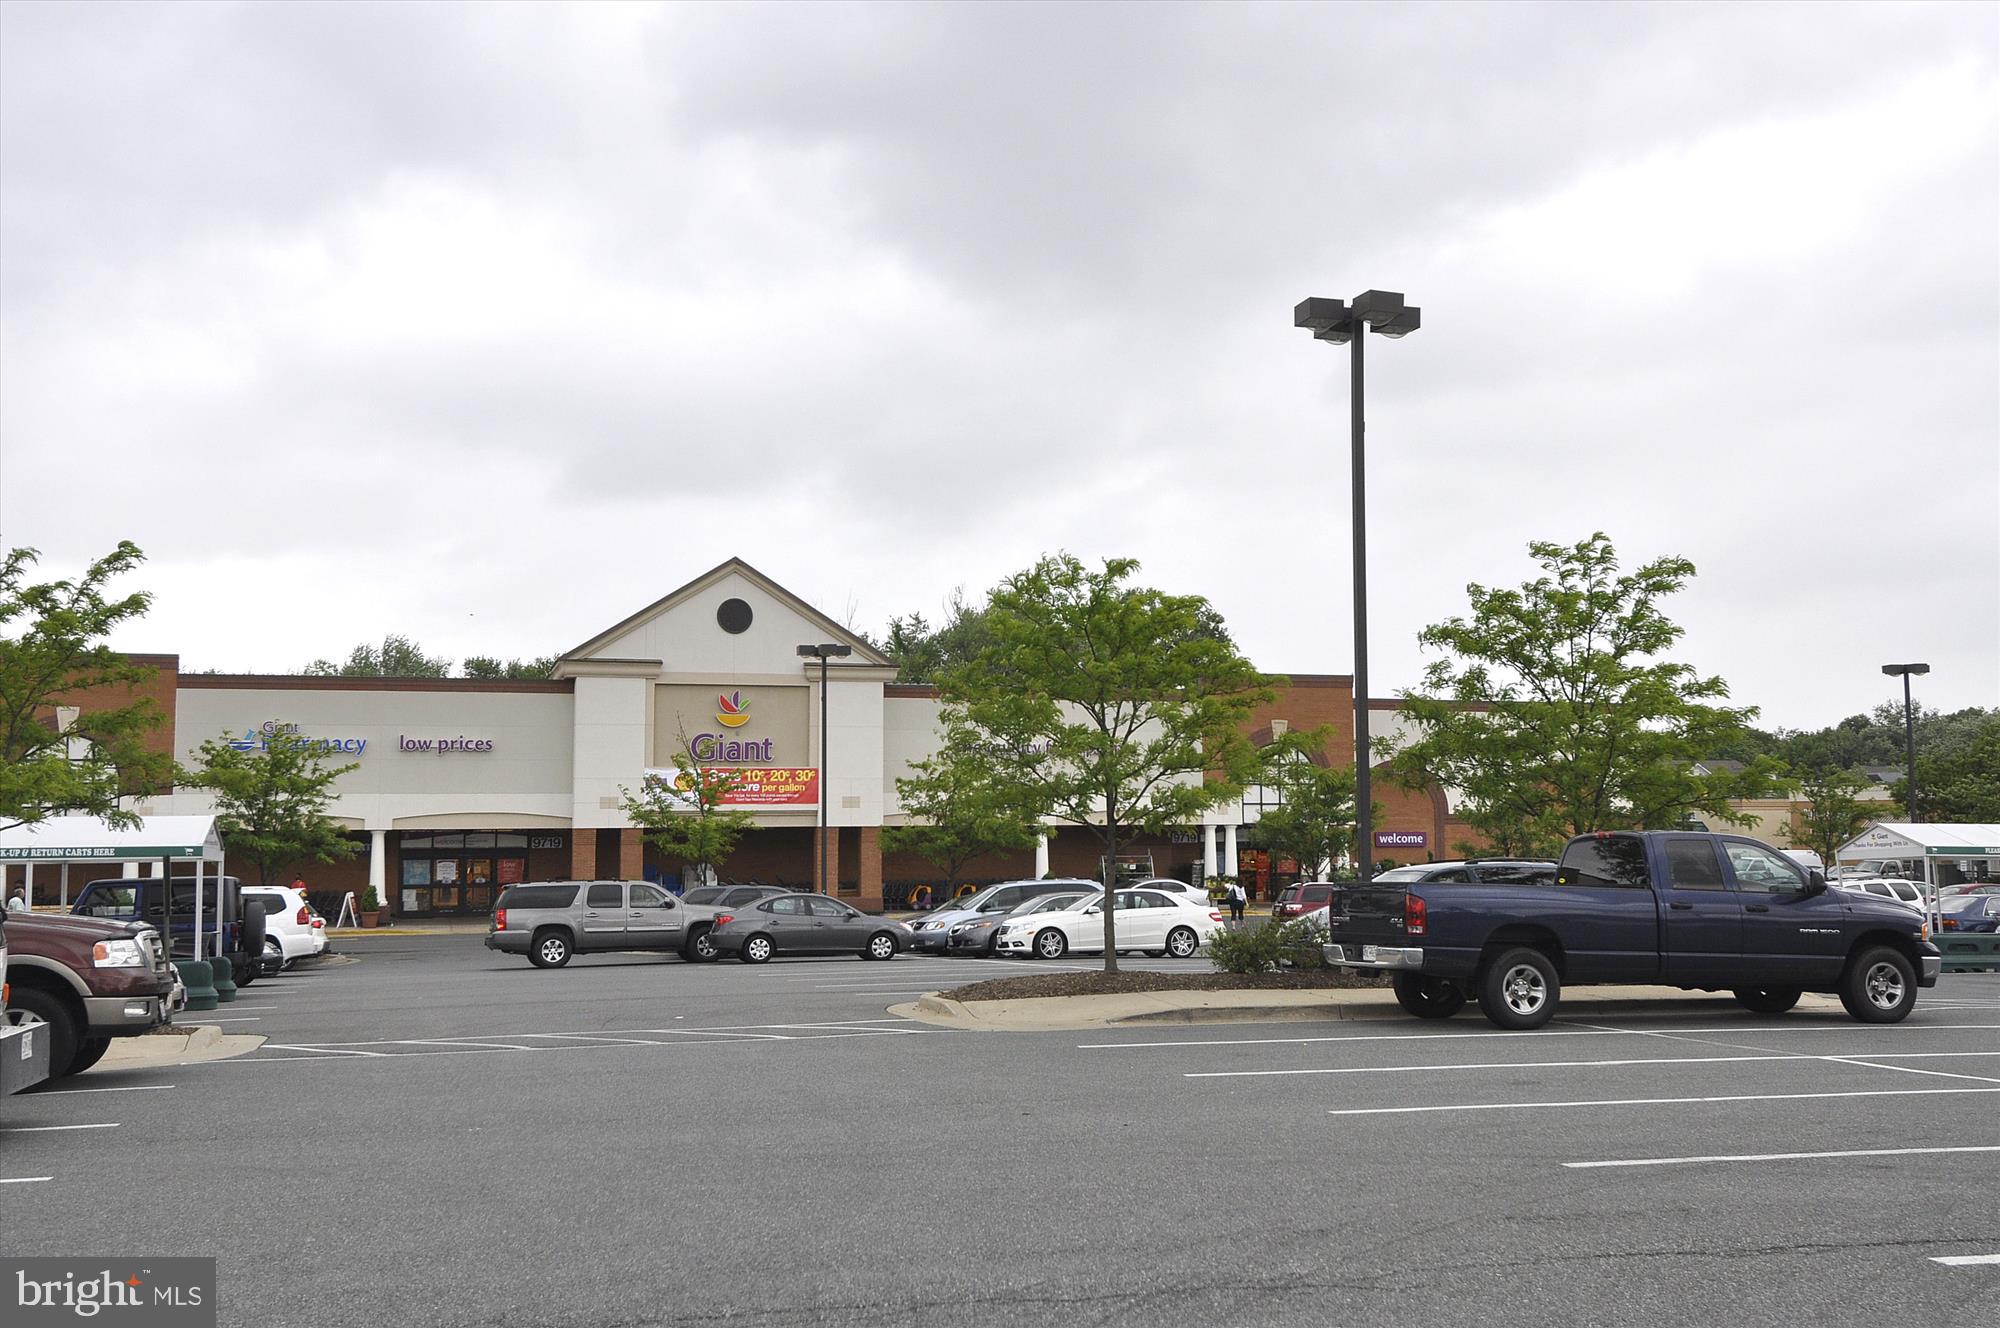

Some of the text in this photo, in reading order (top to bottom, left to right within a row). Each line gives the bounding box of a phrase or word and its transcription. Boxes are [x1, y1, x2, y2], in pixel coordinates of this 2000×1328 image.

[400, 734, 493, 754] low prices
[691, 732, 774, 761] Giant
[762, 784, 777, 793] per
[779, 783, 805, 793] gallon
[533, 837, 561, 848] 9719
[1379, 833, 1424, 844] welcome
[22, 849, 28, 857] &
[31, 848, 64, 857] RETURN
[65, 848, 91, 857] CARTS
[93, 848, 115, 856] HERE
